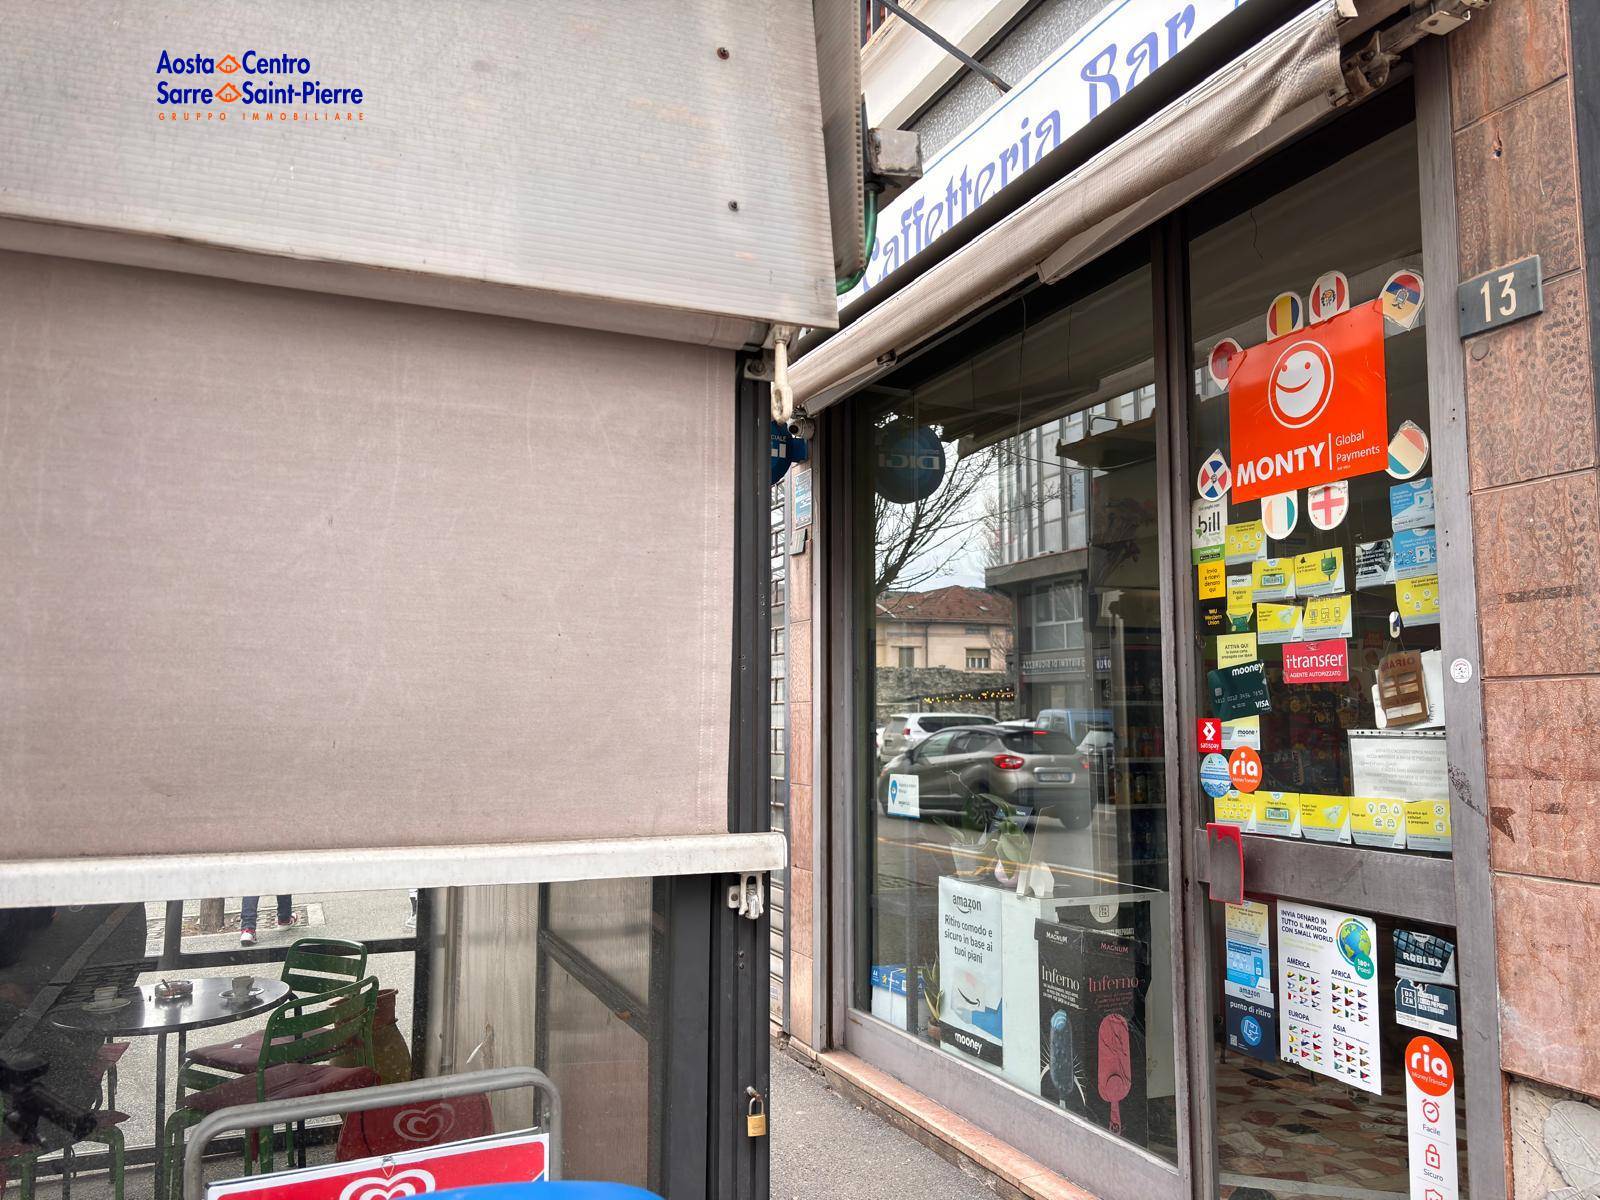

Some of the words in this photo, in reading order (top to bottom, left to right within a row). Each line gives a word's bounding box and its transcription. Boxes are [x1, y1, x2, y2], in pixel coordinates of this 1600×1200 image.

[862, 109, 1061, 293] Caffetteria
[1080, 4, 1196, 118] Bar
[1481, 271, 1517, 323] 13
[1335, 430, 1365, 447] Global
[1335, 444, 1380, 463] Payments
[1236, 441, 1326, 488] MONTY
[1198, 511, 1221, 533] bill
[1232, 662, 1264, 676] mooney
[1254, 700, 1270, 709] VISA
[1232, 752, 1258, 776] ria
[952, 893, 982, 911] amazon
[1281, 909, 1296, 918] INVIA
[1297, 913, 1320, 924] DENARO
[944, 914, 962, 931] Ritiro
[961, 921, 986, 936] comodo
[987, 930, 993, 938] e
[1281, 918, 1298, 927] TUTTO
[1305, 923, 1328, 934] MONDO
[1281, 926, 1294, 934] CON
[1295, 928, 1312, 938] SMALL
[1313, 933, 1333, 943] WORLD
[944, 930, 964, 943] sicuro
[963, 934, 969, 944] in
[970, 936, 985, 950] base
[986, 942, 993, 952] ai
[1046, 931, 1068, 943] MAGNUM
[954, 946, 967, 958] tuoi
[968, 949, 983, 964] piani
[1100, 942, 1129, 953] MAGNUM
[1286, 957, 1310, 969] AMERICA
[1402, 952, 1442, 968] ROBLOX
[1042, 965, 1080, 991] Inferno
[1331, 969, 1351, 979] AFRICA
[1088, 975, 1139, 993] Inferno
[1239, 987, 1260, 998] amazon
[1230, 1001, 1248, 1012] punto
[1248, 1005, 1255, 1013] di
[1255, 1008, 1272, 1018] ritiro
[1288, 1009, 1310, 1022] EUROPA
[1333, 1023, 1346, 1033] ASIA
[955, 1031, 983, 1055] mooney
[1410, 1044, 1448, 1078] ria
[1422, 1123, 1441, 1136] Facile
[1423, 1168, 1444, 1182] Sicuro
